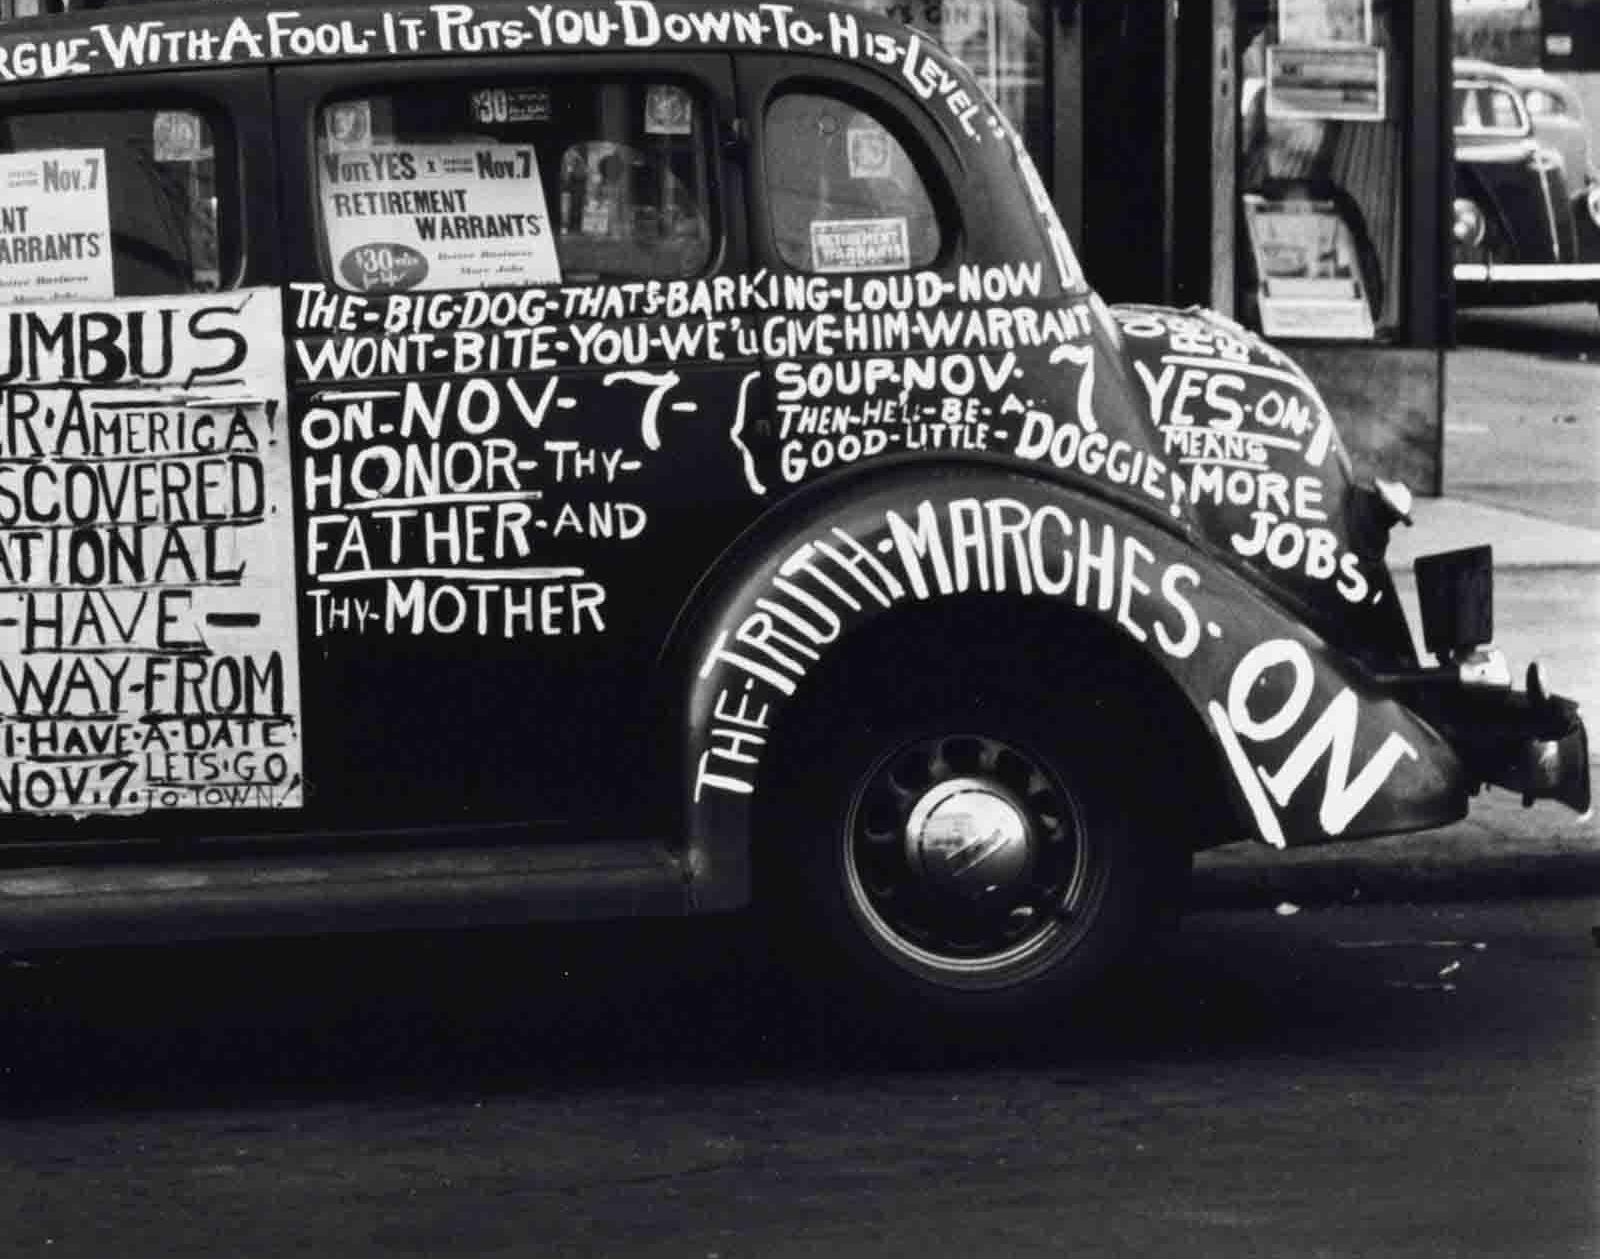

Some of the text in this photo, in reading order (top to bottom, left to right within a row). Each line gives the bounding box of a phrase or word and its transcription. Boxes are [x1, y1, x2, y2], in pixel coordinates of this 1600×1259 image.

[94, 20, 213, 69] WITH
[267, 11, 368, 58] FOOL
[430, 4, 525, 52] PUTS
[527, 4, 611, 46] YOU
[828, 11, 898, 64] HIS
[331, 188, 468, 219] RETIREMENT
[414, 213, 541, 241] WARRANTS
[289, 261, 1043, 333] THE BIG DOG BARKING LOUD NOW
[453, 325, 557, 372] BITE
[570, 322, 650, 365] YOU
[844, 311, 913, 351] HIM
[774, 359, 895, 402] SOUP
[1133, 359, 1247, 433] YES
[300, 401, 377, 449] ON
[776, 400, 852, 440] THEN
[304, 438, 623, 511] HONOR THY
[779, 422, 990, 483] GOOD LITTLE
[1190, 463, 1328, 523] MORE
[306, 502, 648, 576] FATHER AND
[23, 590, 214, 656] HAVE
[385, 579, 606, 638] MOTHER
[142, 650, 285, 719] FROM
[183, 719, 288, 749] DATE
[1212, 638, 1419, 844] ON
[233, 751, 289, 785] GO
